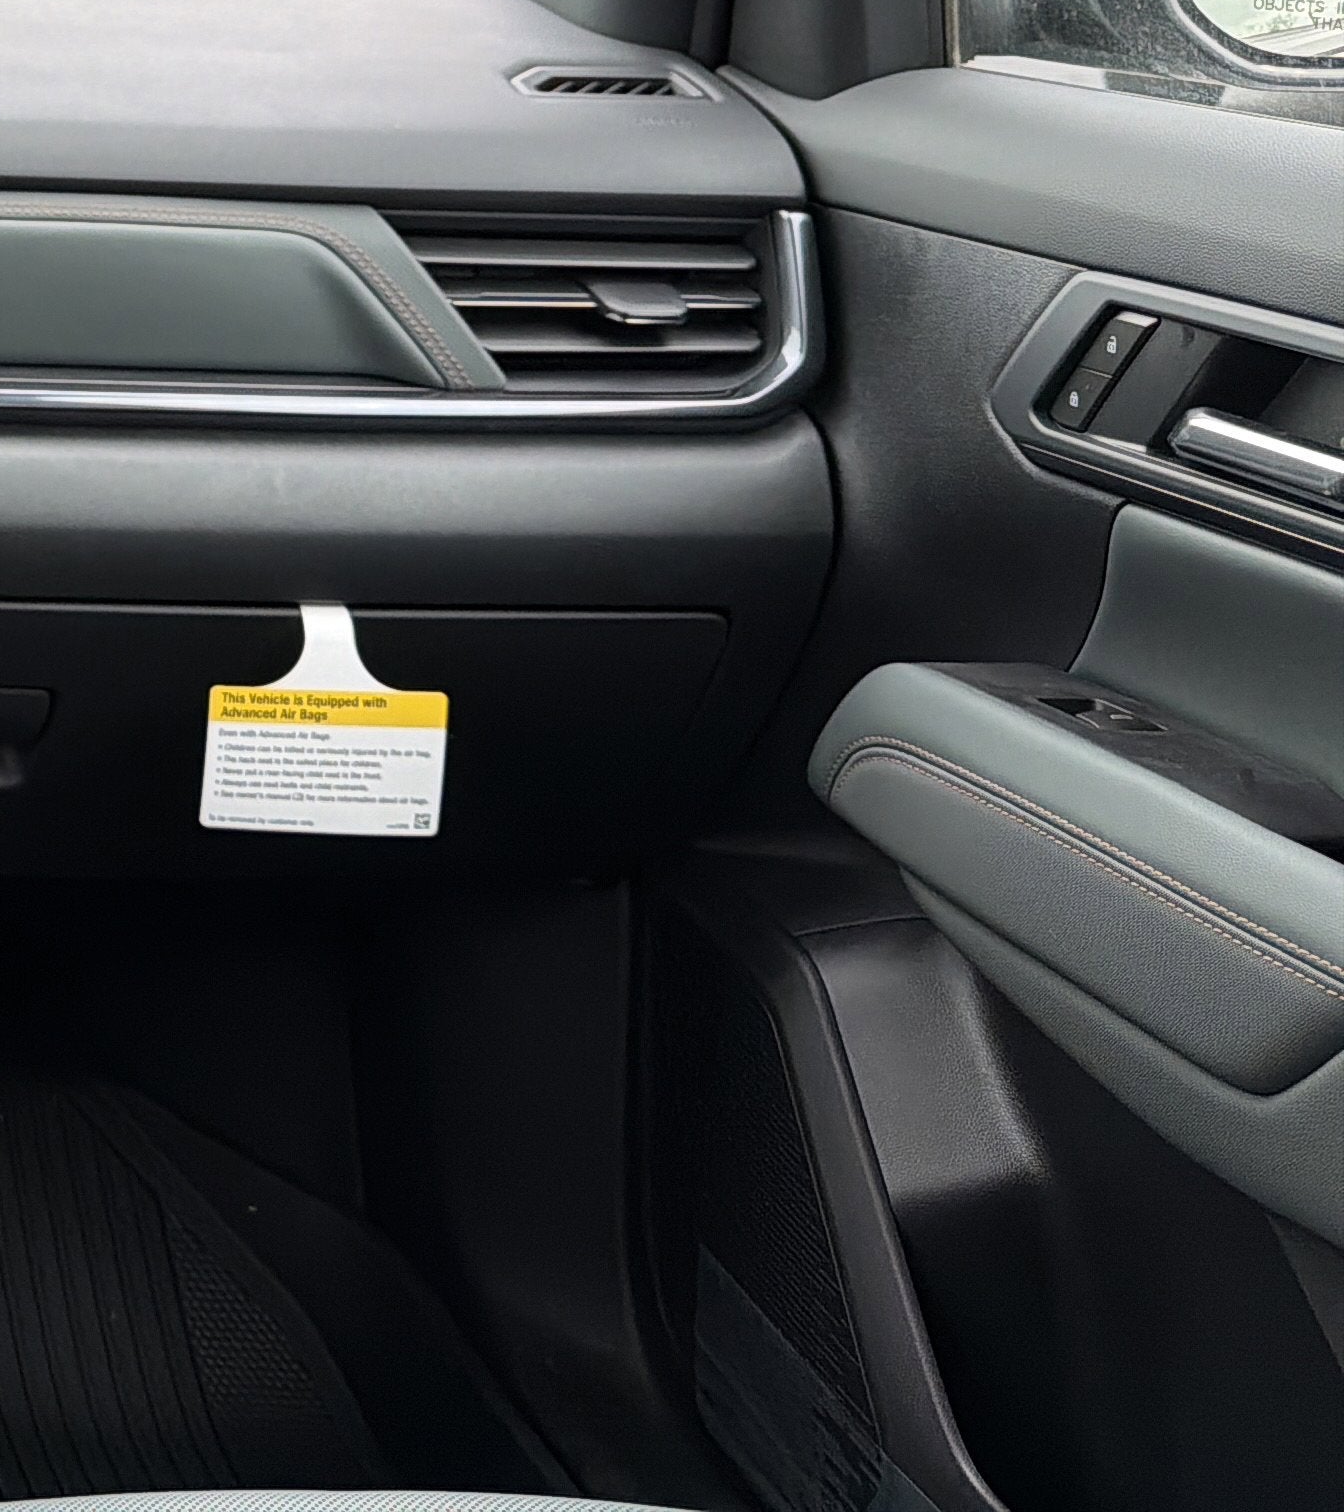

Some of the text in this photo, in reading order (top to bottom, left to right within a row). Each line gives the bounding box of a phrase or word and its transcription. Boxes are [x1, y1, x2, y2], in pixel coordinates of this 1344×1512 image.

[1312, 16, 1344, 30] THA
[222, 692, 387, 709] This Vehicle is Equipped with
[220, 706, 328, 723] Advanced Air Bags
